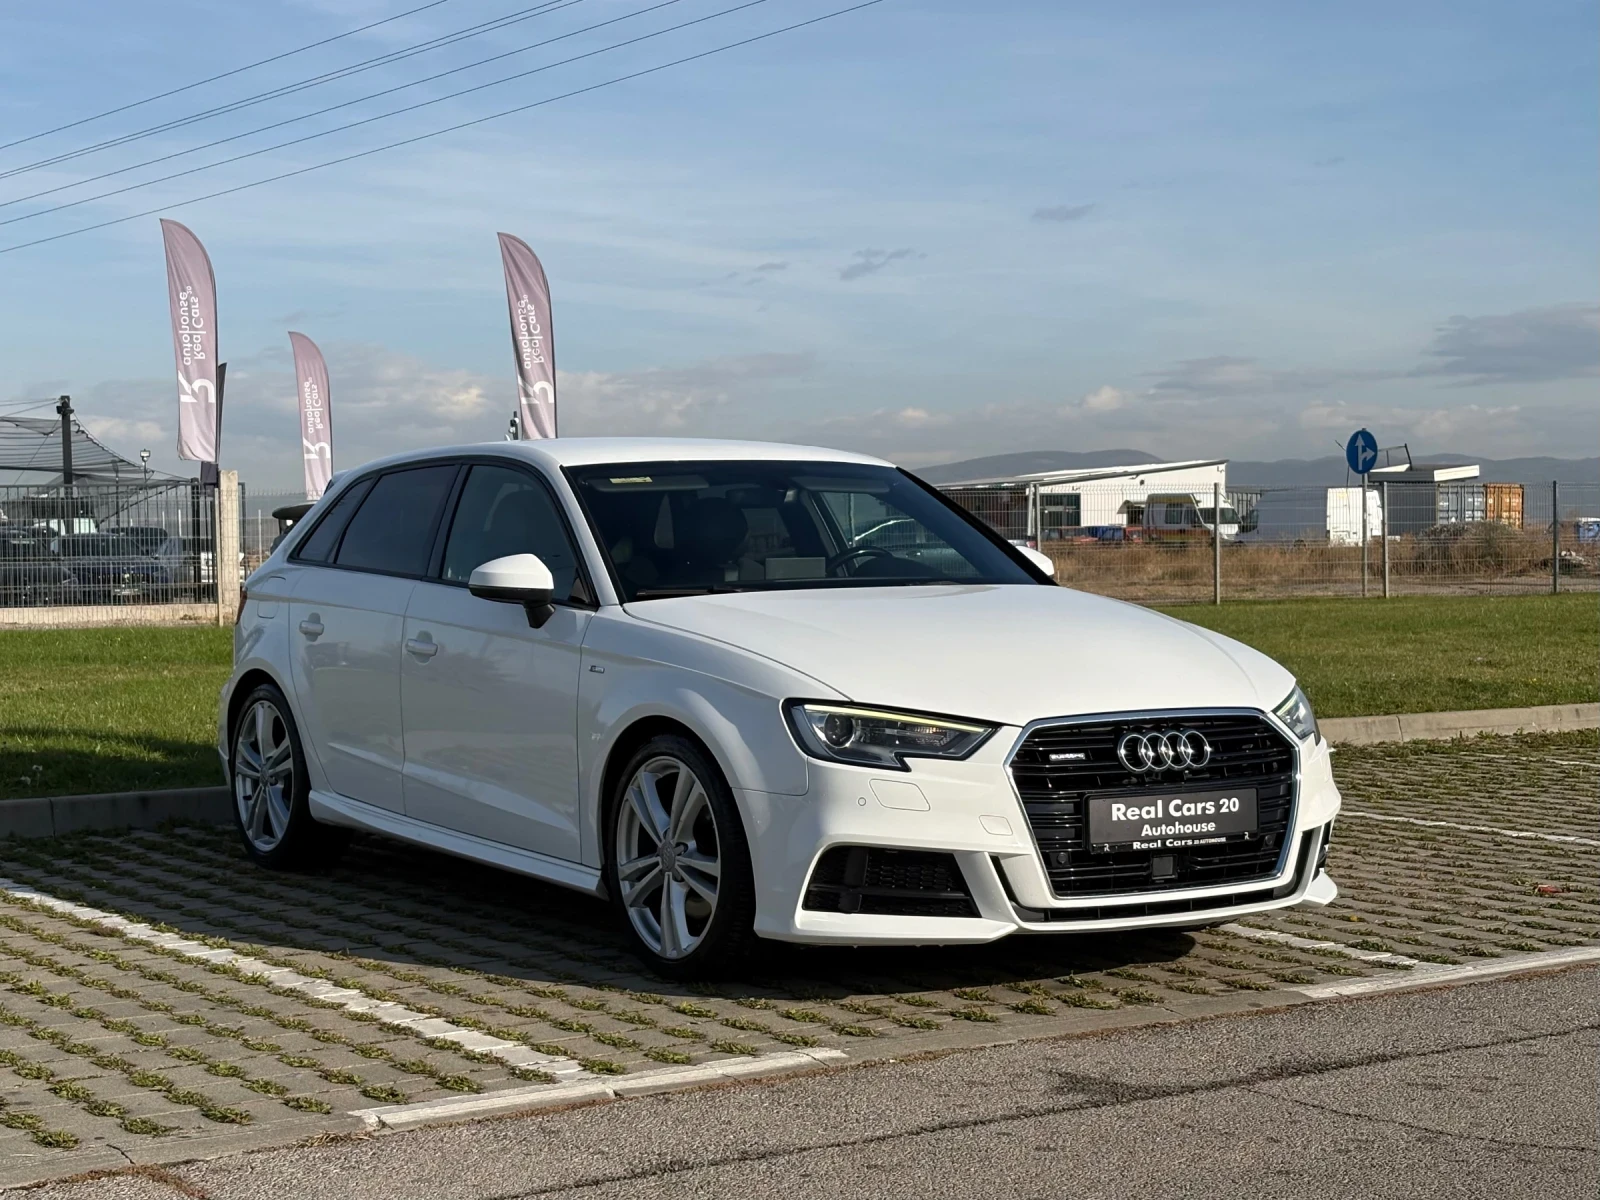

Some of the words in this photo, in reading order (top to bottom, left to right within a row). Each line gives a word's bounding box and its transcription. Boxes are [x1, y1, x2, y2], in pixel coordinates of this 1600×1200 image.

[1111, 800, 1163, 821] Real
[1168, 799, 1215, 817] Cars
[1219, 797, 1240, 813] 20
[1141, 821, 1216, 837] Autohouse
[1132, 840, 1162, 850] Real
[1165, 839, 1193, 847] Cars
